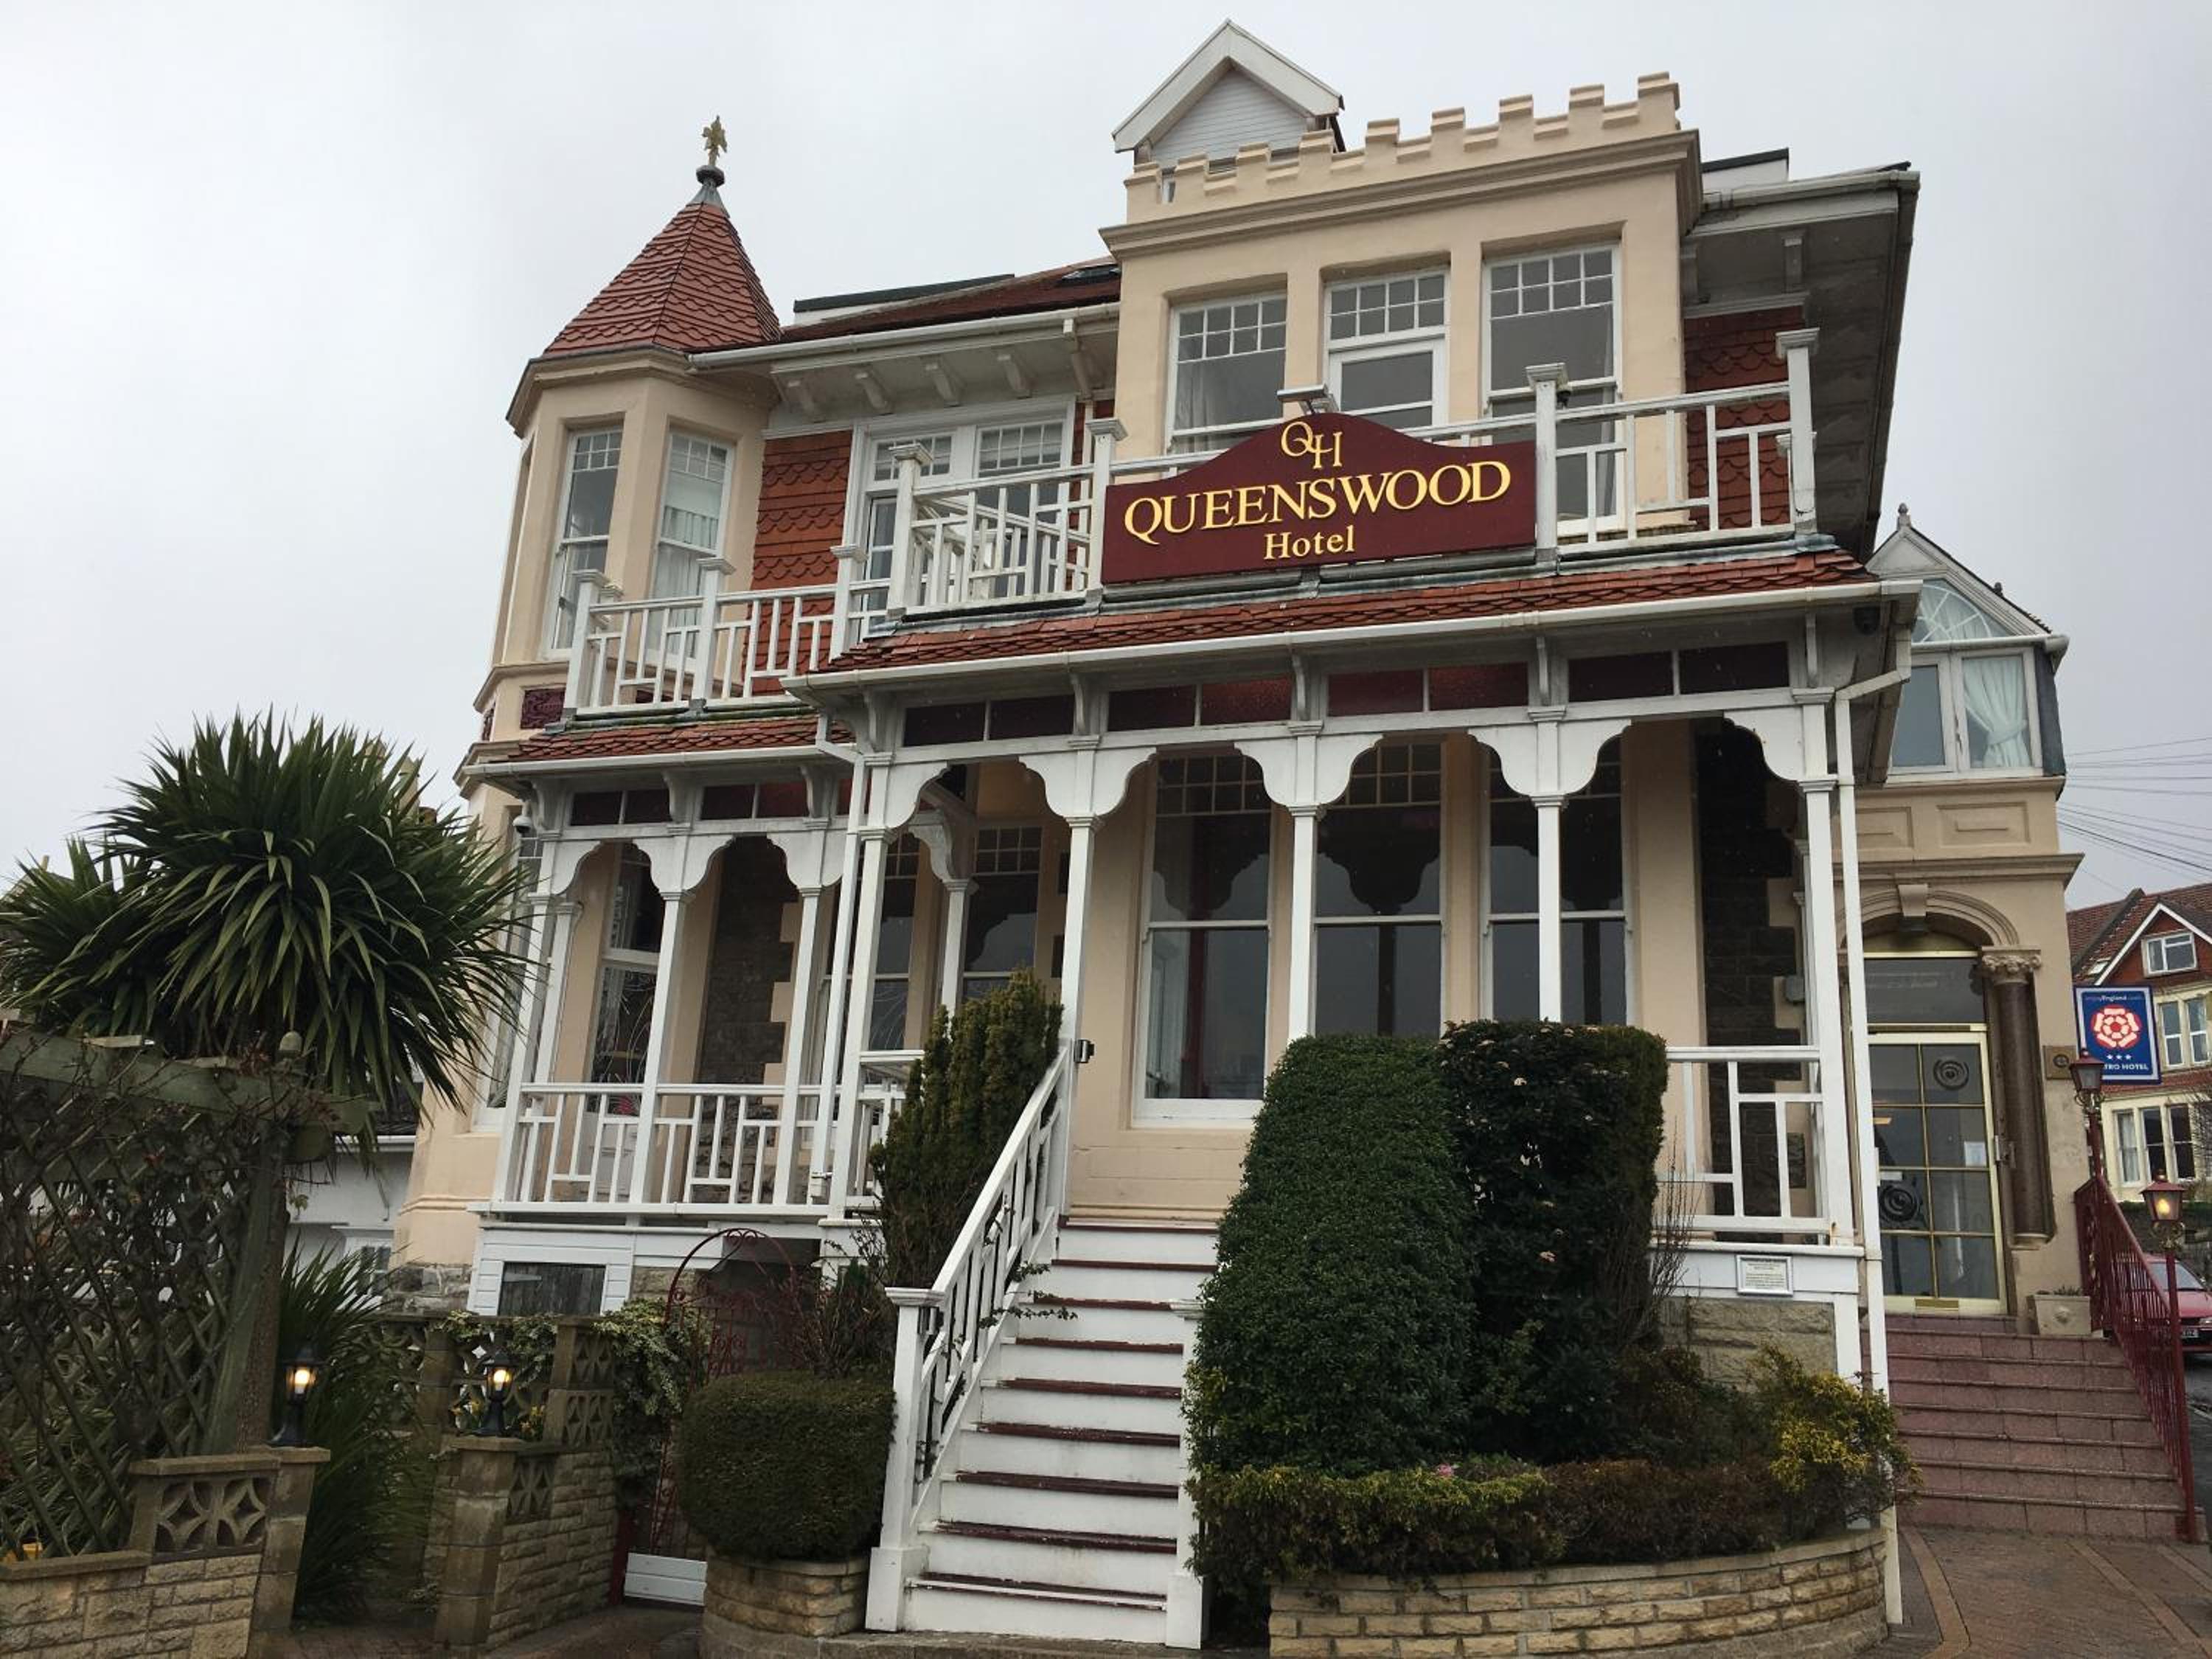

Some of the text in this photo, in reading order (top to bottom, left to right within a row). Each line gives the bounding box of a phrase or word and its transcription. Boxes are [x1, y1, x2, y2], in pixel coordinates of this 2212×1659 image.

[1124, 461, 1511, 545] QUEENSWOOD
[1263, 524, 1355, 560] Hotel
[2121, 1062, 2149, 1071] HOTEL
